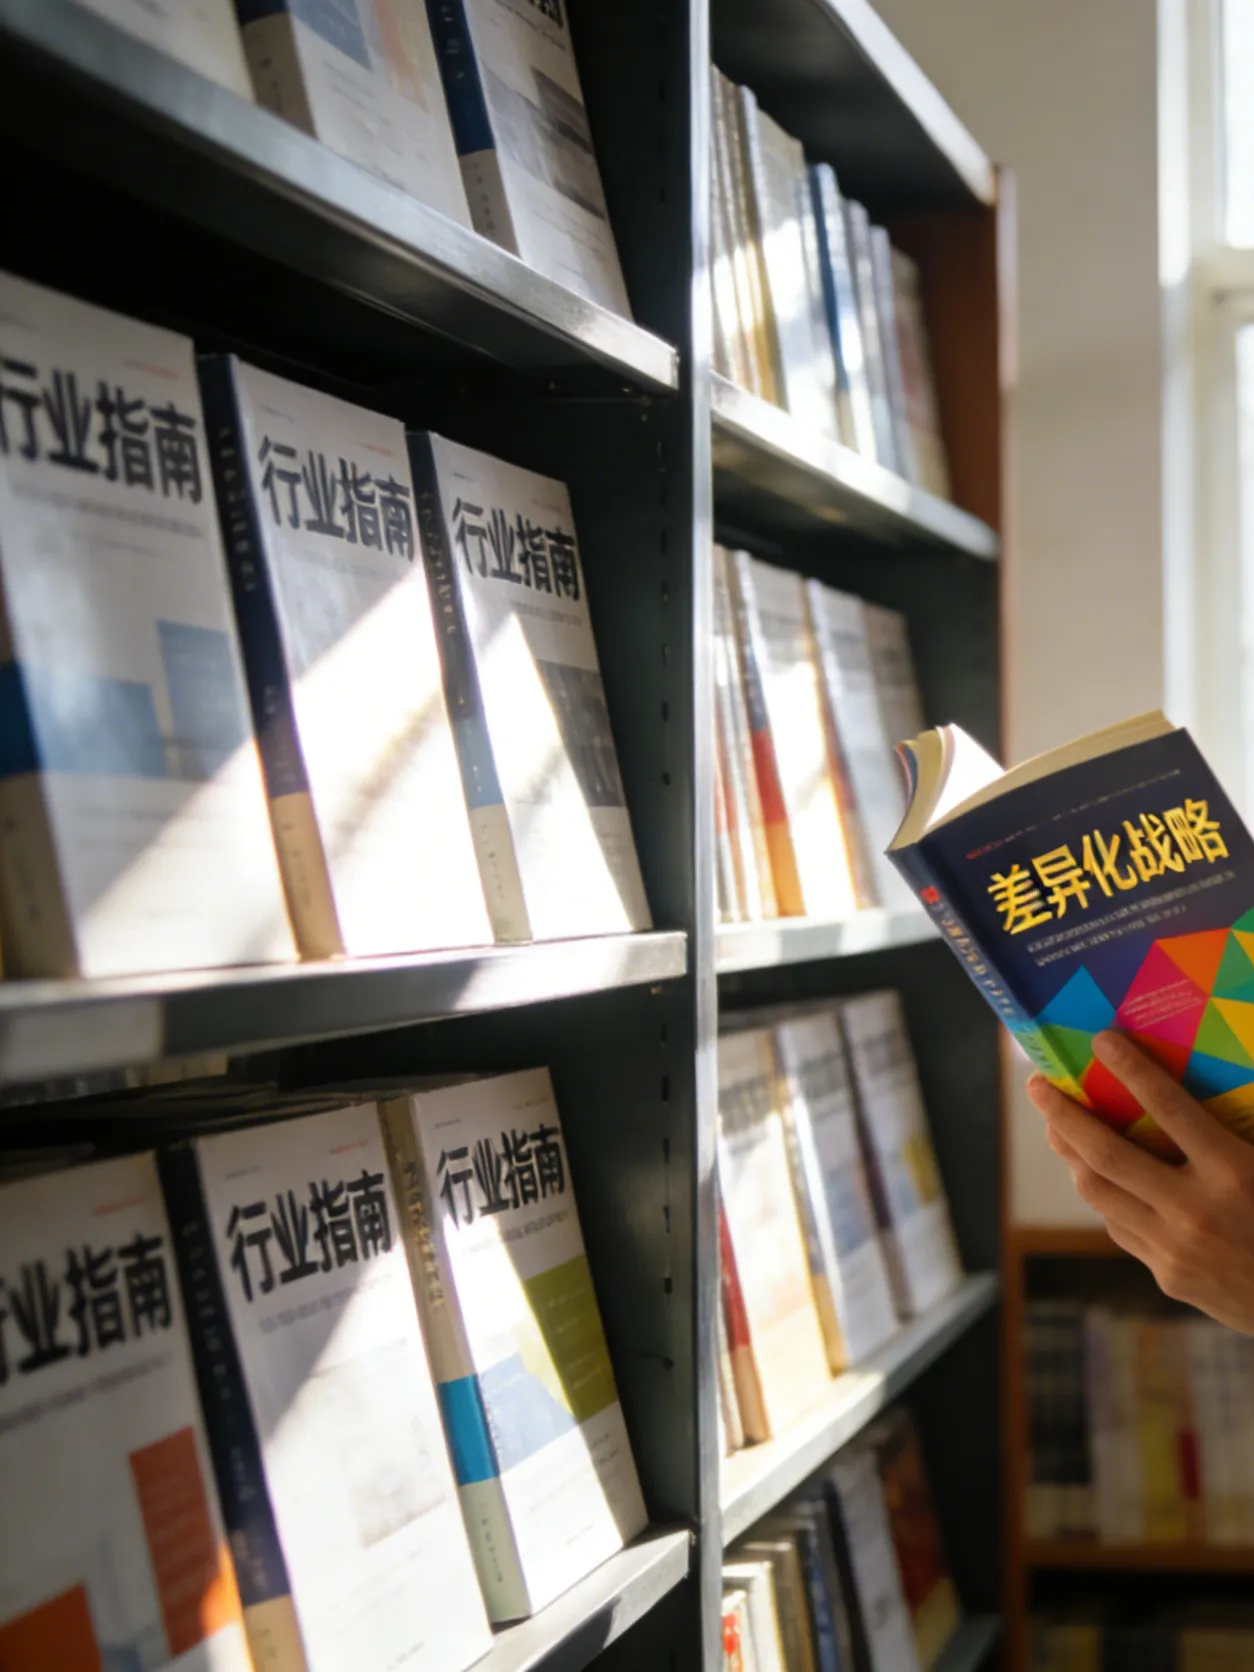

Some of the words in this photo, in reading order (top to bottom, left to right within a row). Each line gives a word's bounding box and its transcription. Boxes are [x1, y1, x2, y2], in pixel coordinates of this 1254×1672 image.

[258, 434, 414, 563] 行业指南
[452, 497, 581, 602] 行业指南
[986, 798, 1230, 936] 差异化战略
[226, 1169, 393, 1303] 行业指南
[437, 1123, 567, 1231] 行业指南
[0, 1228, 172, 1386] 业指南
